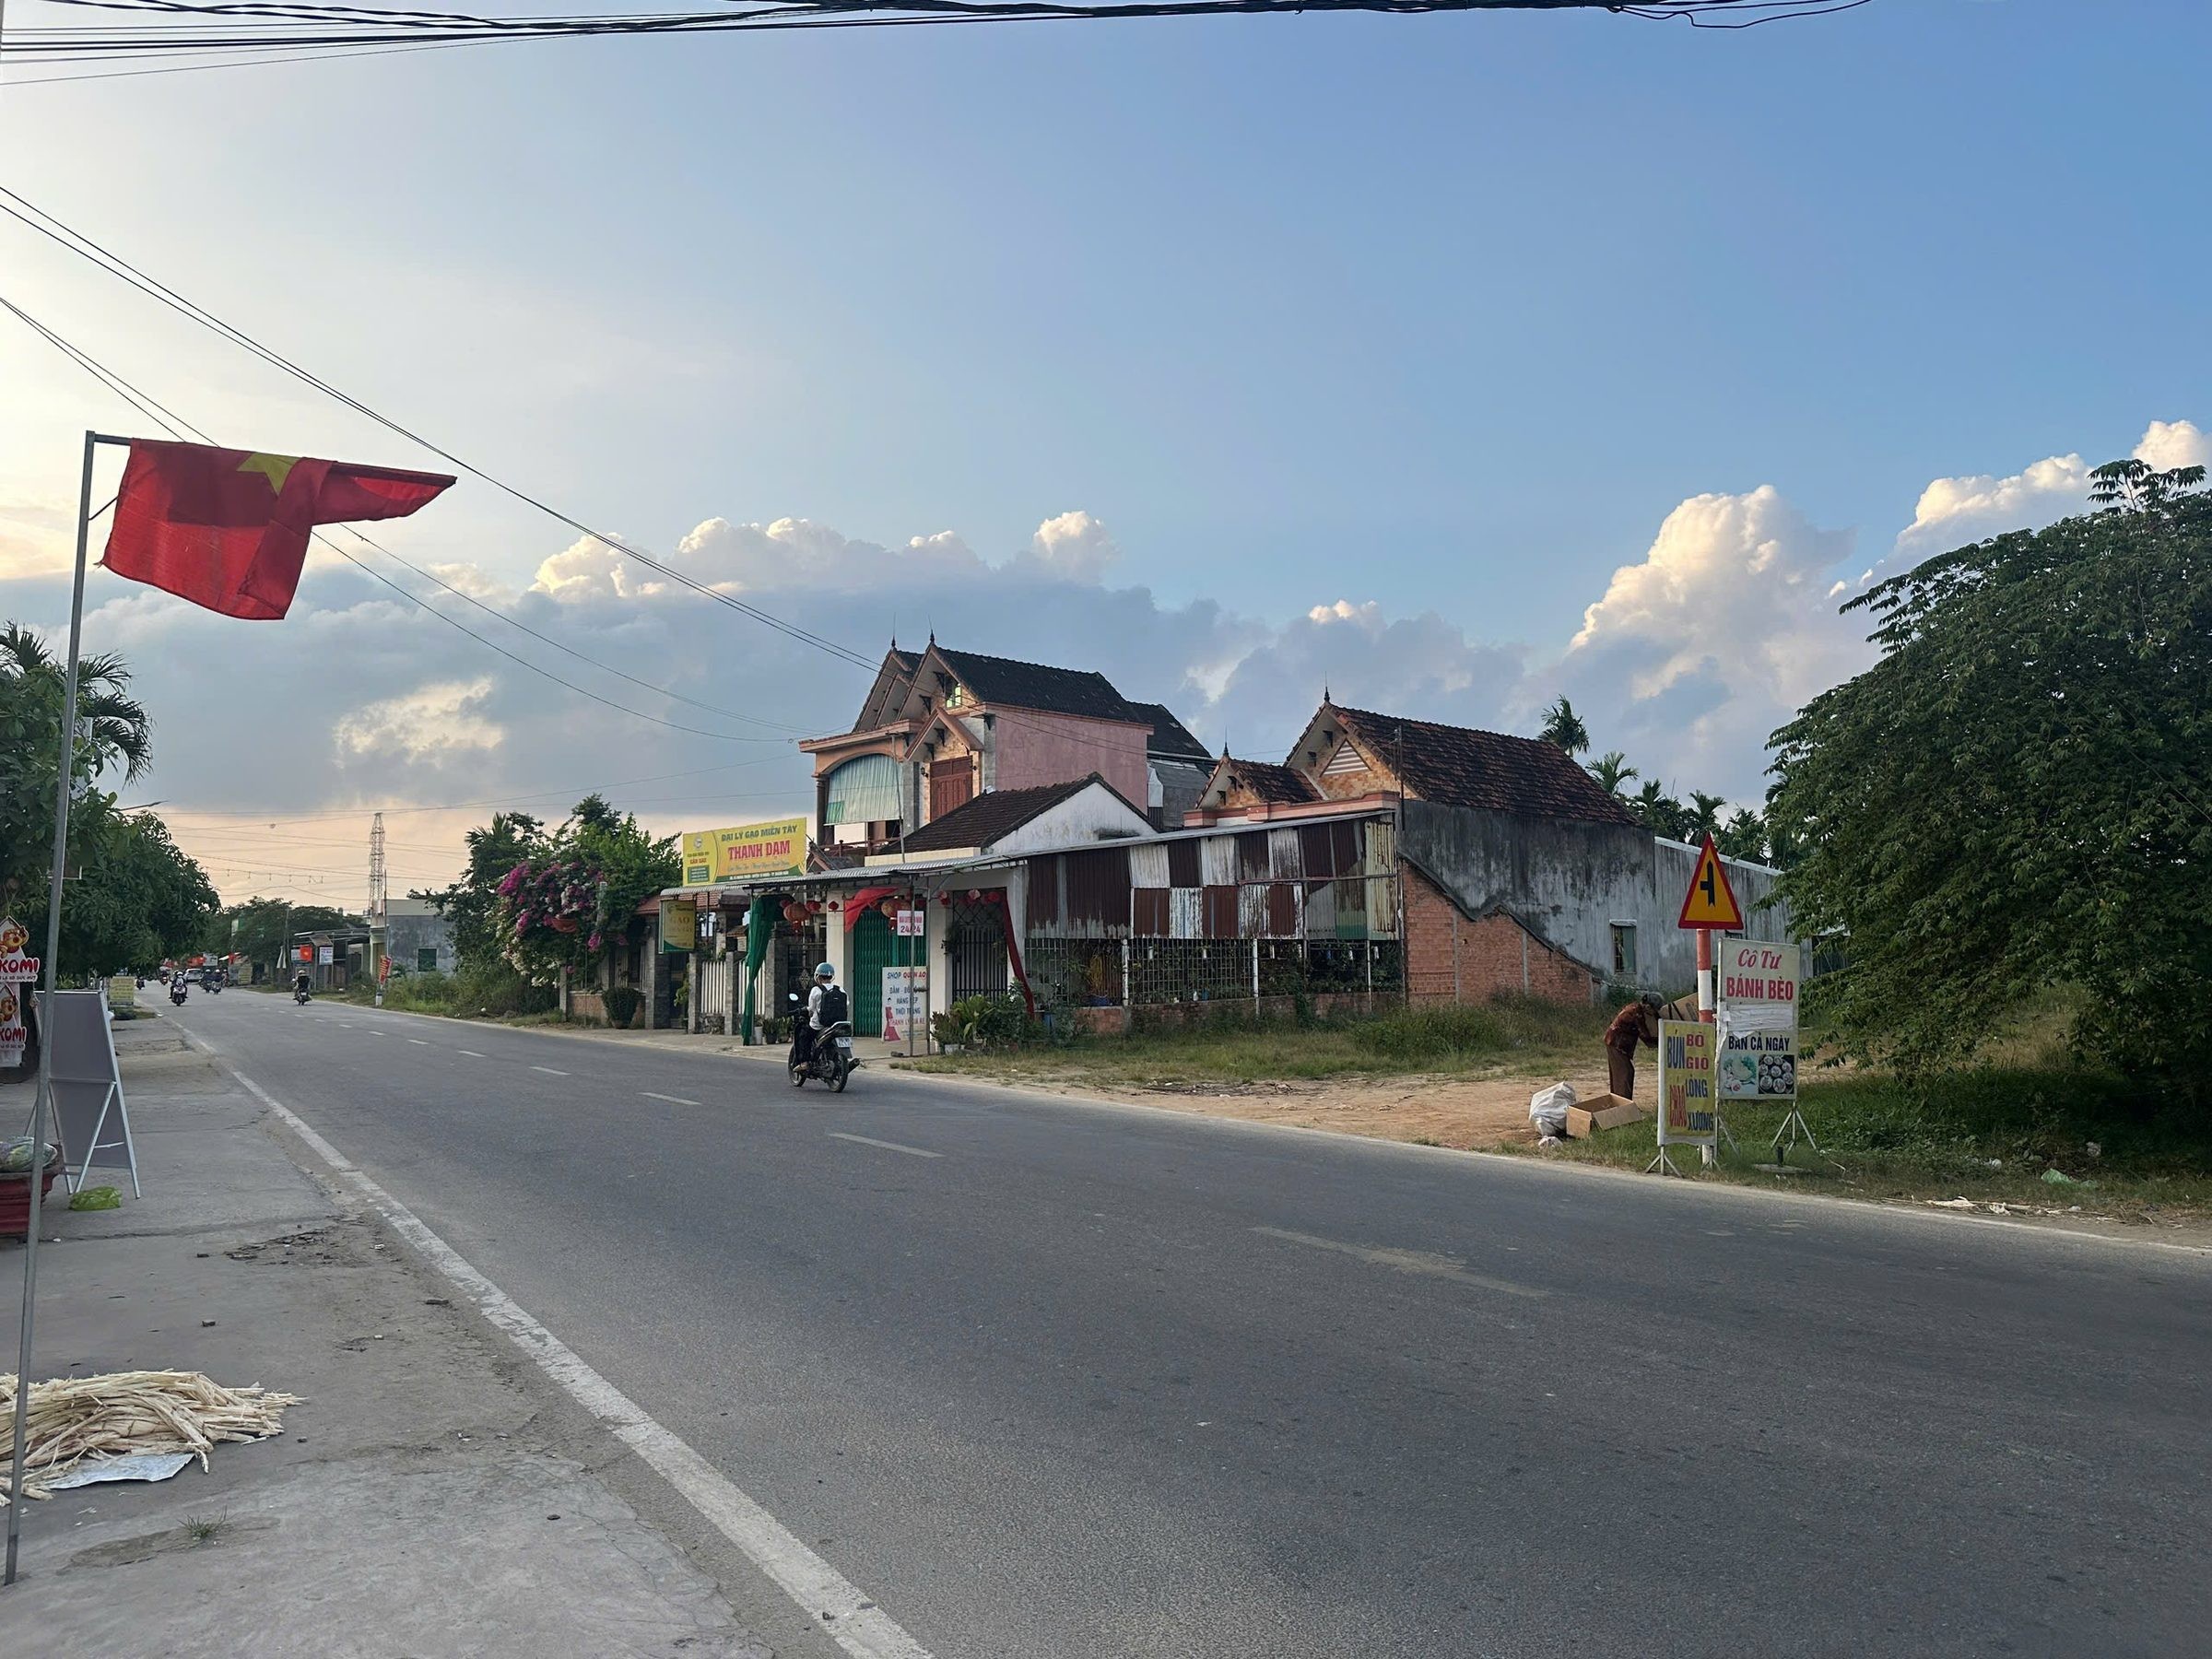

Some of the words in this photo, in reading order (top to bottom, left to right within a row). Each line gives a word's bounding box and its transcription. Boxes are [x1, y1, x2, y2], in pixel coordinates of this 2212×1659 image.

[727, 842, 764, 861] THANH
[1737, 948, 1758, 968] Cô
[1760, 950, 1783, 970] Tư
[887, 971, 902, 980] SHOP
[903, 971, 918, 980] QUN
[1726, 973, 1764, 999] BÁNH
[1768, 976, 1794, 1001] BÈO
[1666, 1029, 1685, 1069] BÚN
[1750, 1032, 1763, 1051] CẢ
[1765, 1034, 1791, 1052] NGÀY
[1686, 1054, 1710, 1070] GIÒ
[1685, 1074, 1709, 1099] LÒNG
[1688, 1110, 1714, 1132] XƯƠNG
